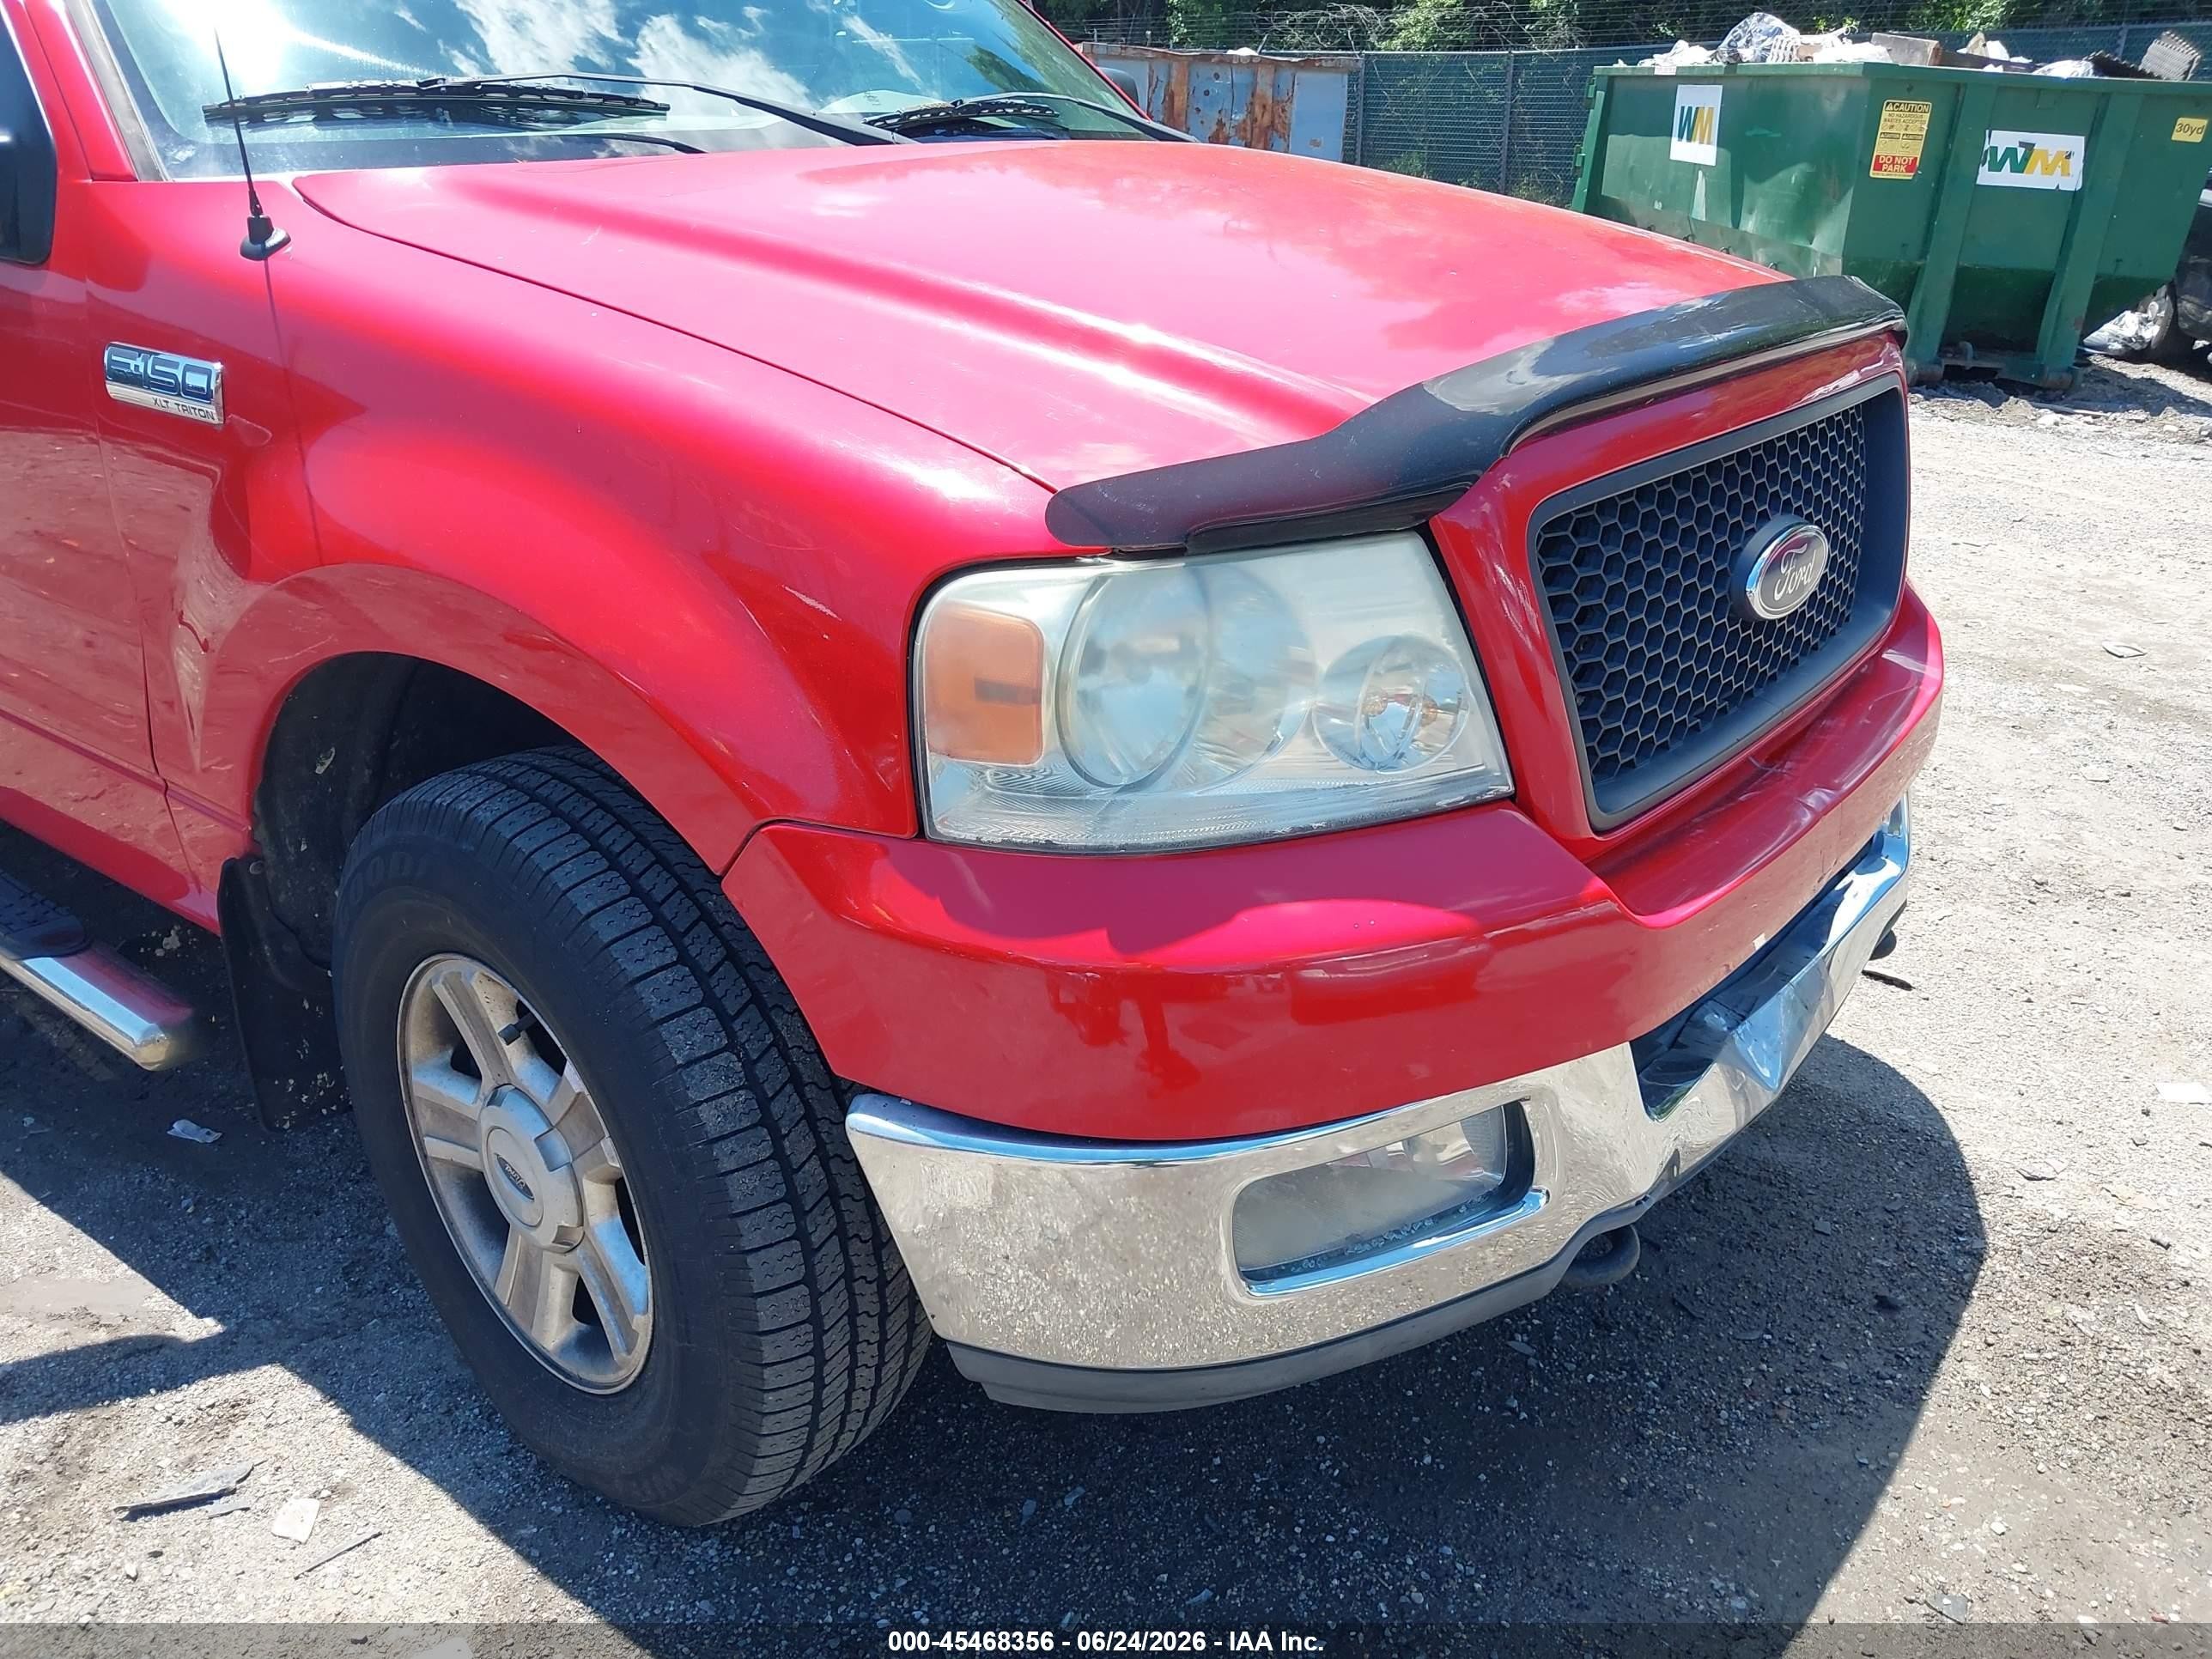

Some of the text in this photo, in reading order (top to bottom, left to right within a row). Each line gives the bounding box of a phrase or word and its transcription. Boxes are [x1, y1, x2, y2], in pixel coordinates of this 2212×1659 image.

[1893, 103, 1929, 112] CAUTION
[1677, 106, 1715, 145] WM
[2176, 123, 2205, 137] 30yd
[1879, 155, 1914, 166] DO NOT
[1988, 141, 2070, 177] WM
[152, 397, 215, 421] XLT TRITON
[1774, 543, 1816, 601] Ford
